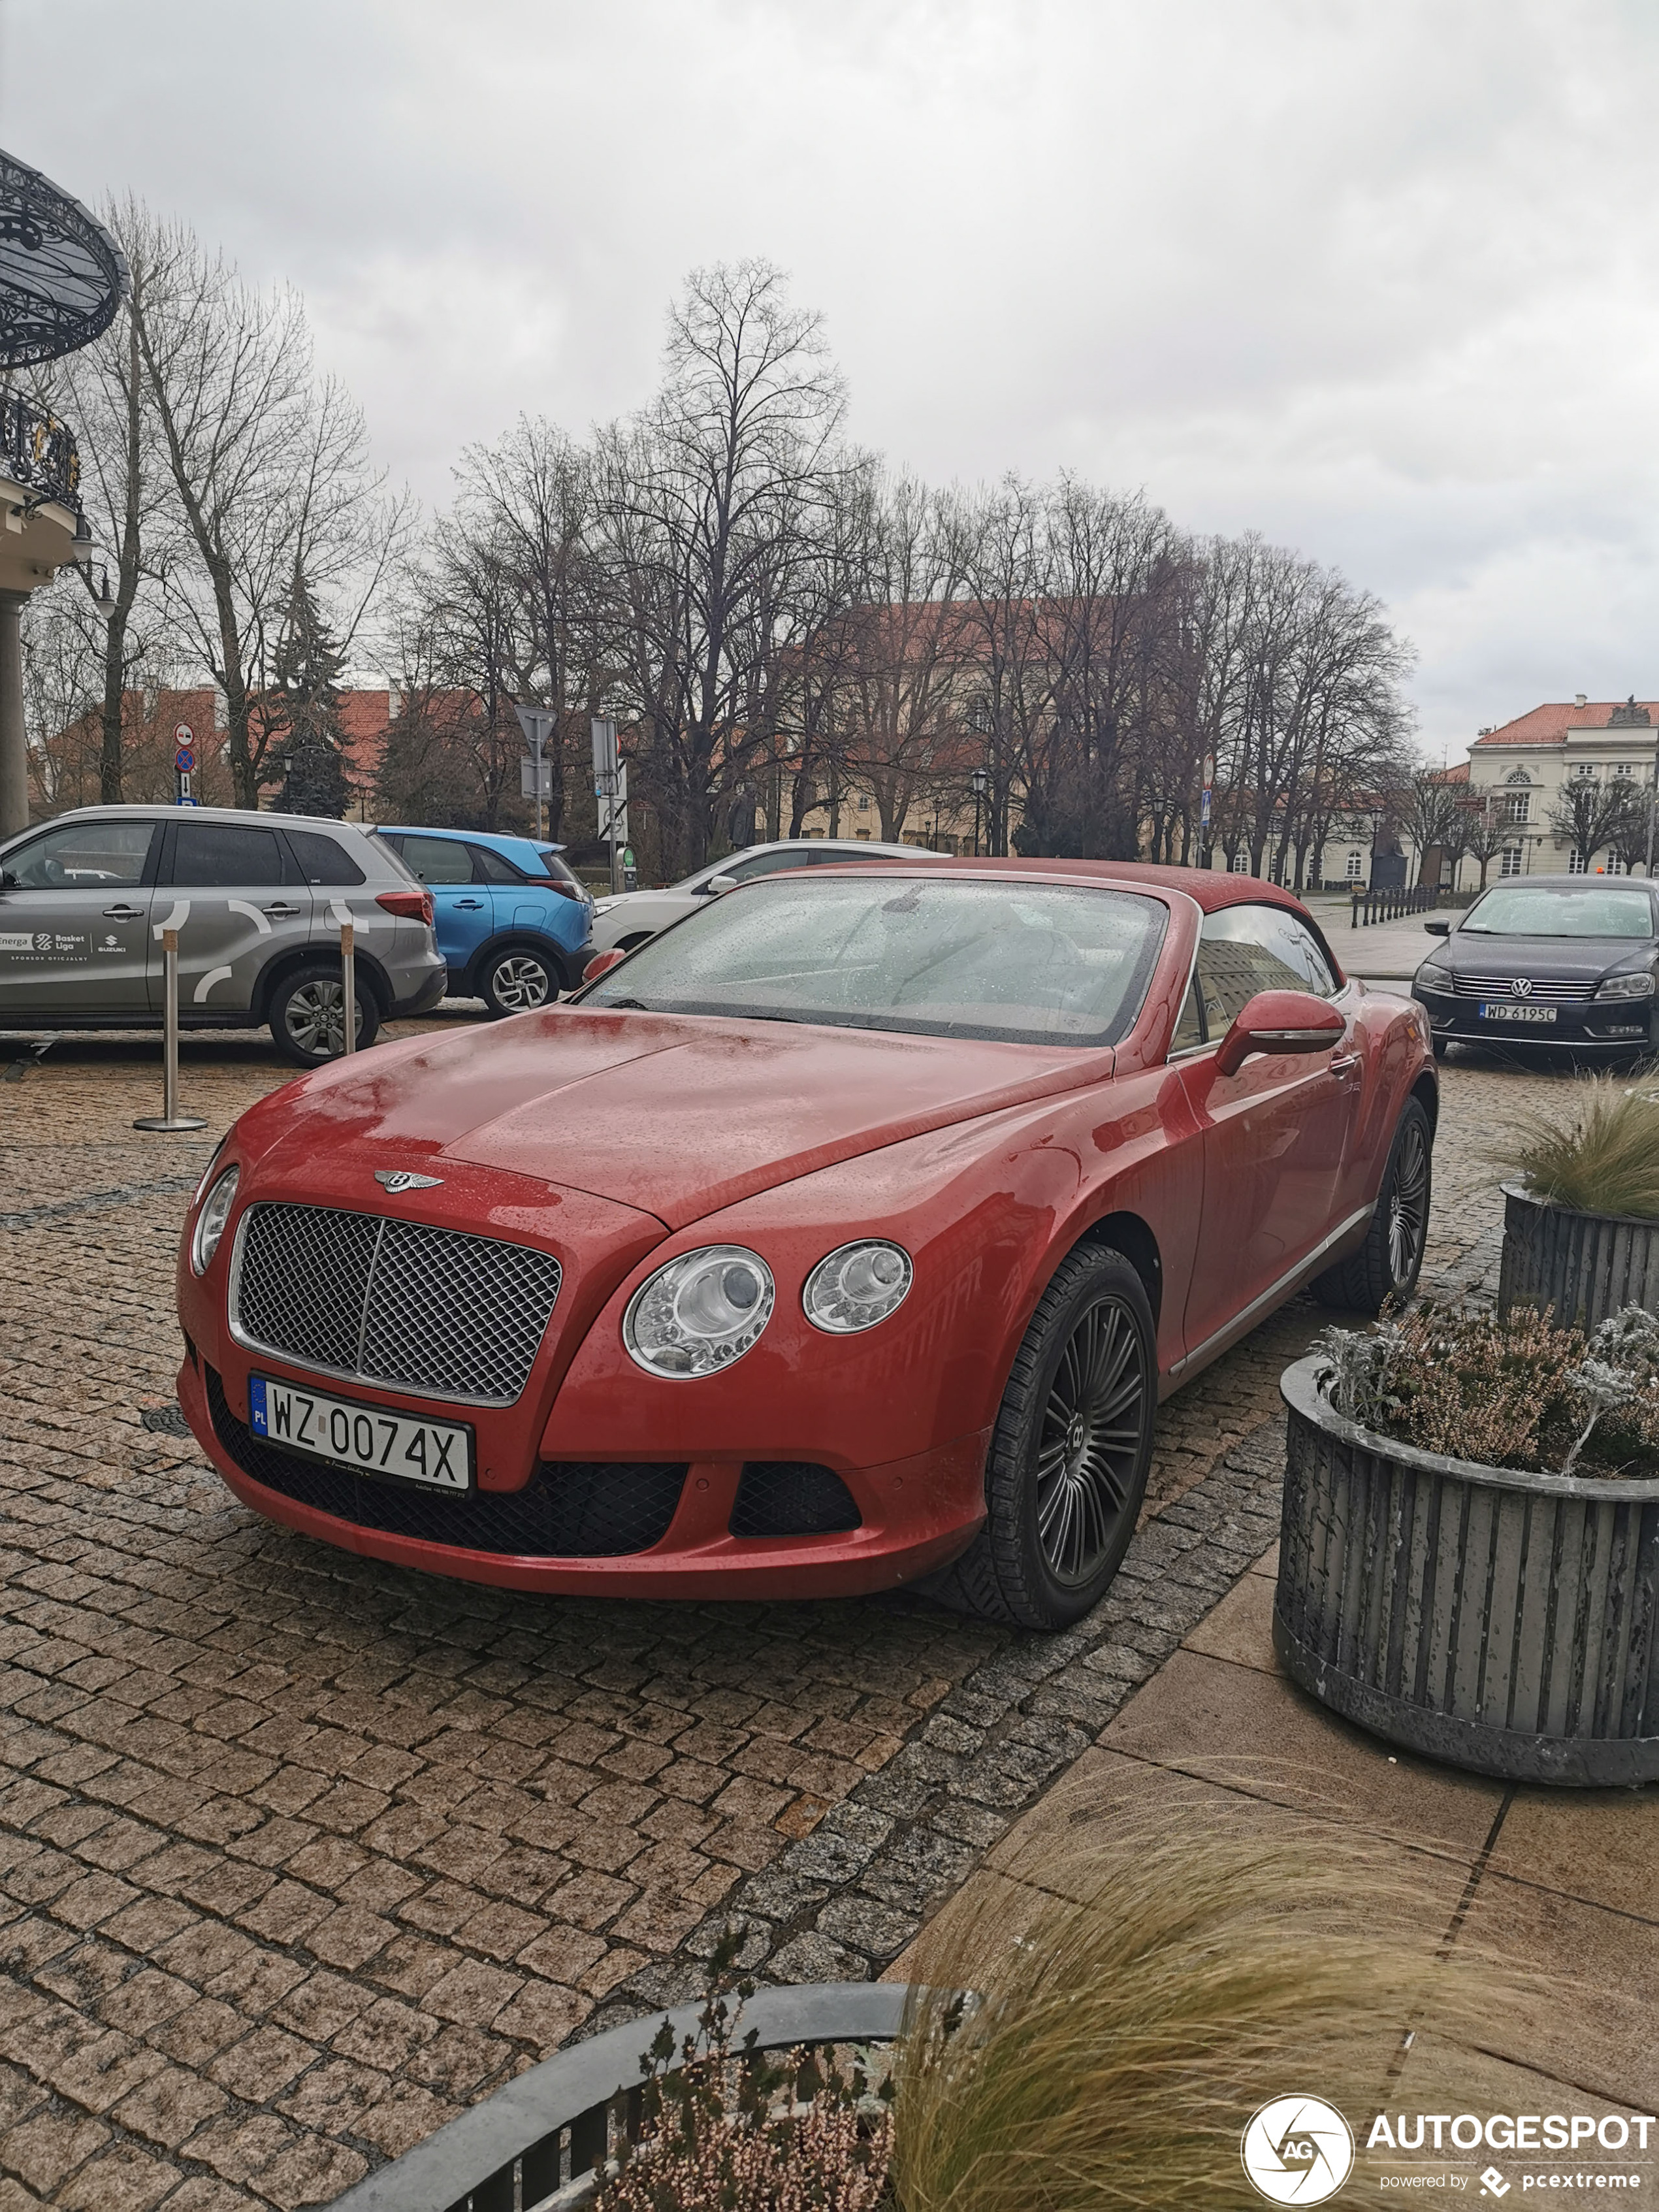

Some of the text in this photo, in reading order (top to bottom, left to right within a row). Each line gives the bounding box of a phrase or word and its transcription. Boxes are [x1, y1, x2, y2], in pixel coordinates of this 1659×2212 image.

[1488, 1005, 1555, 1021] WD 6195C
[255, 1410, 266, 1425] PL
[273, 1389, 457, 1482] WZ 0074X
